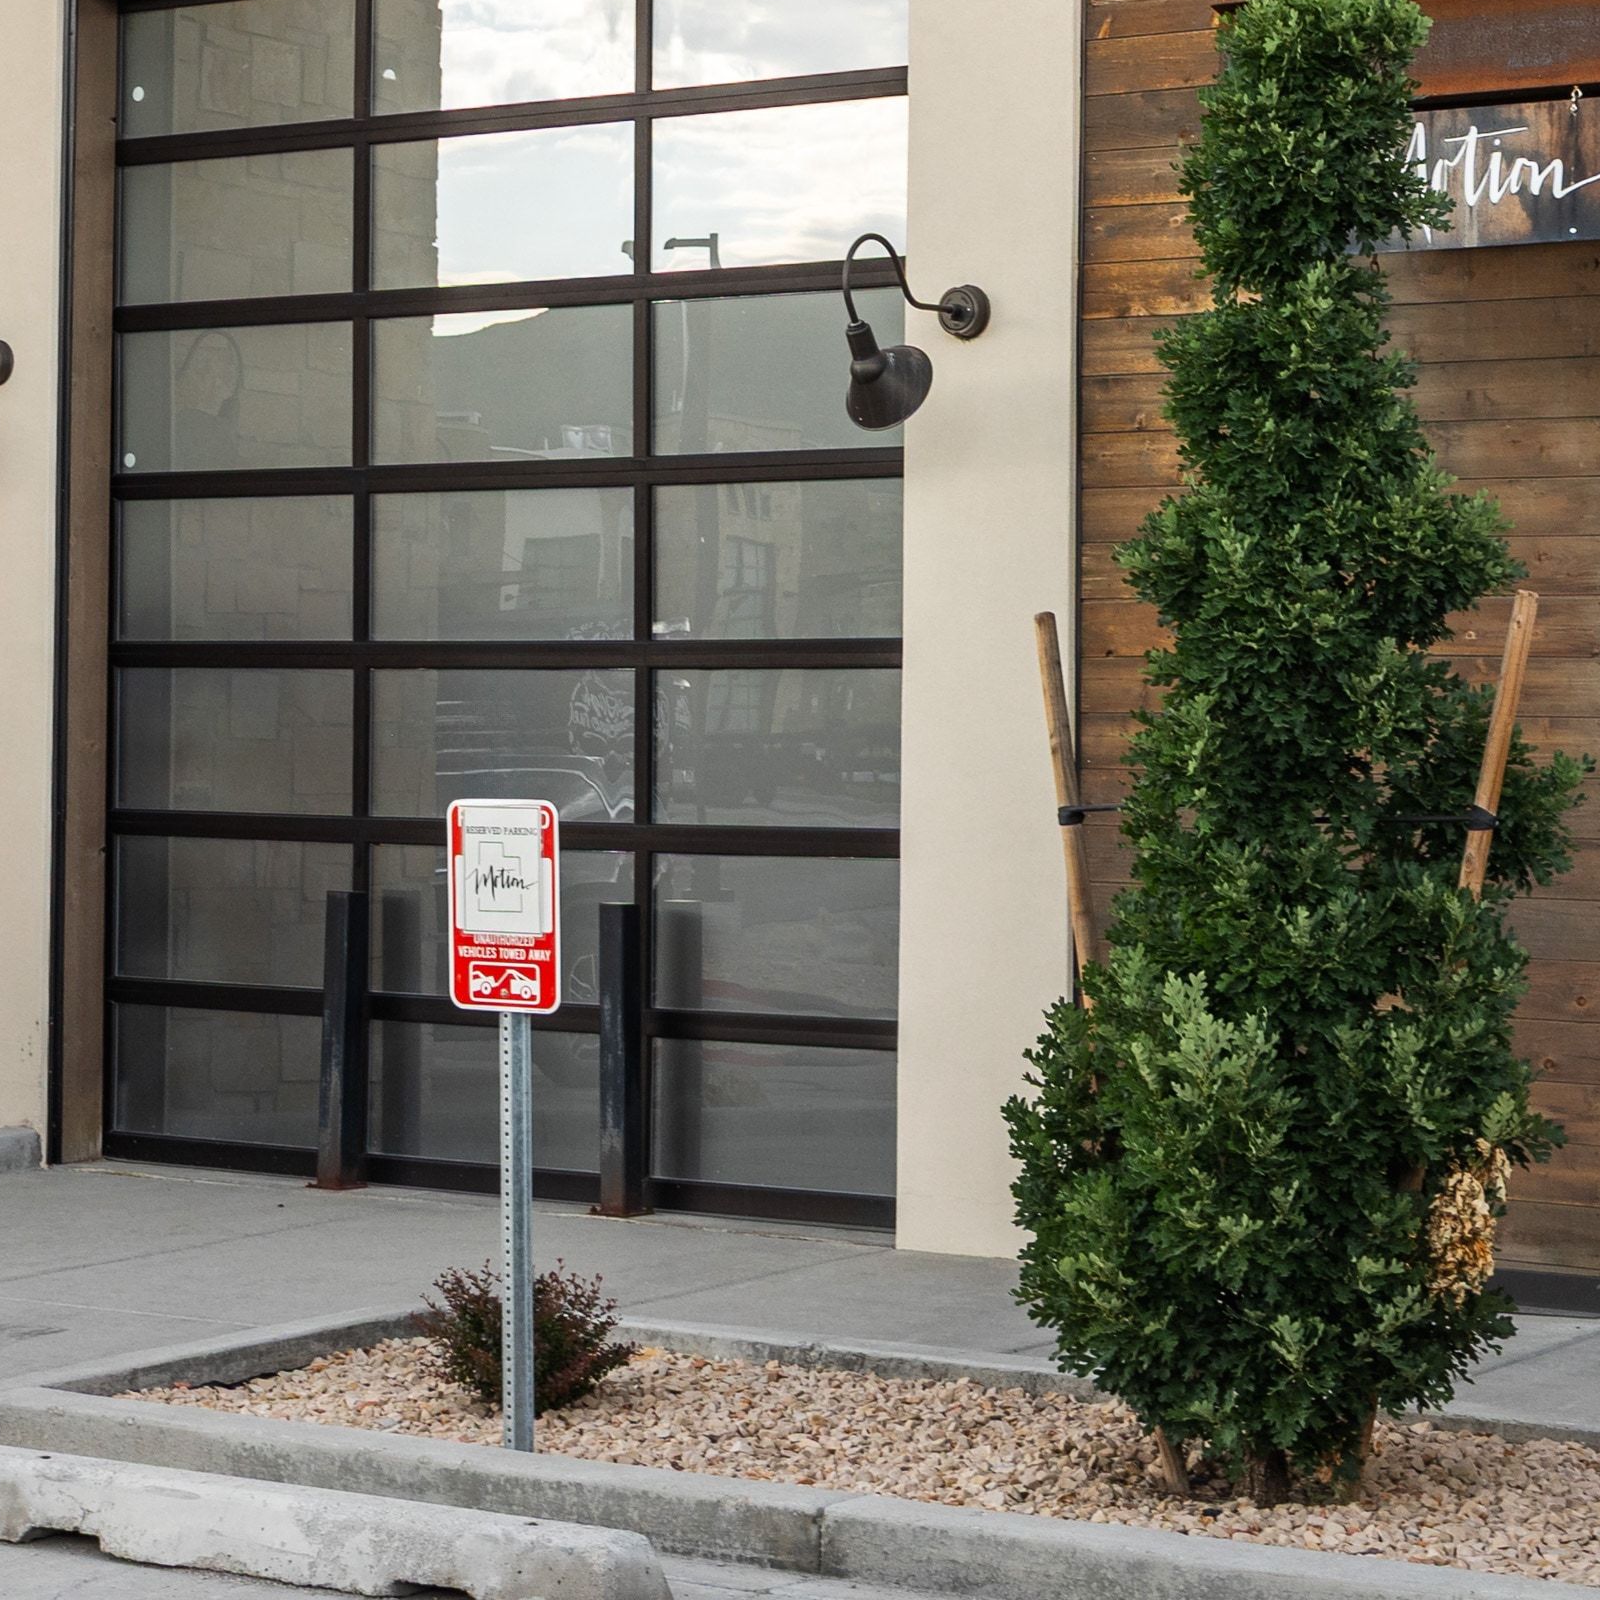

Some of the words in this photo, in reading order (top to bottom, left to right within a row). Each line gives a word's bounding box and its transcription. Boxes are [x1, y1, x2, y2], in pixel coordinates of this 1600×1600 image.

[466, 826, 502, 835] RESERVED
[503, 827, 538, 836] PARKING
[465, 865, 538, 901] Motion
[473, 934, 535, 947] UNAUTHORIZED
[457, 945, 498, 959] VEHICLES
[499, 947, 527, 960] TOWED
[528, 949, 552, 962] AWAY
